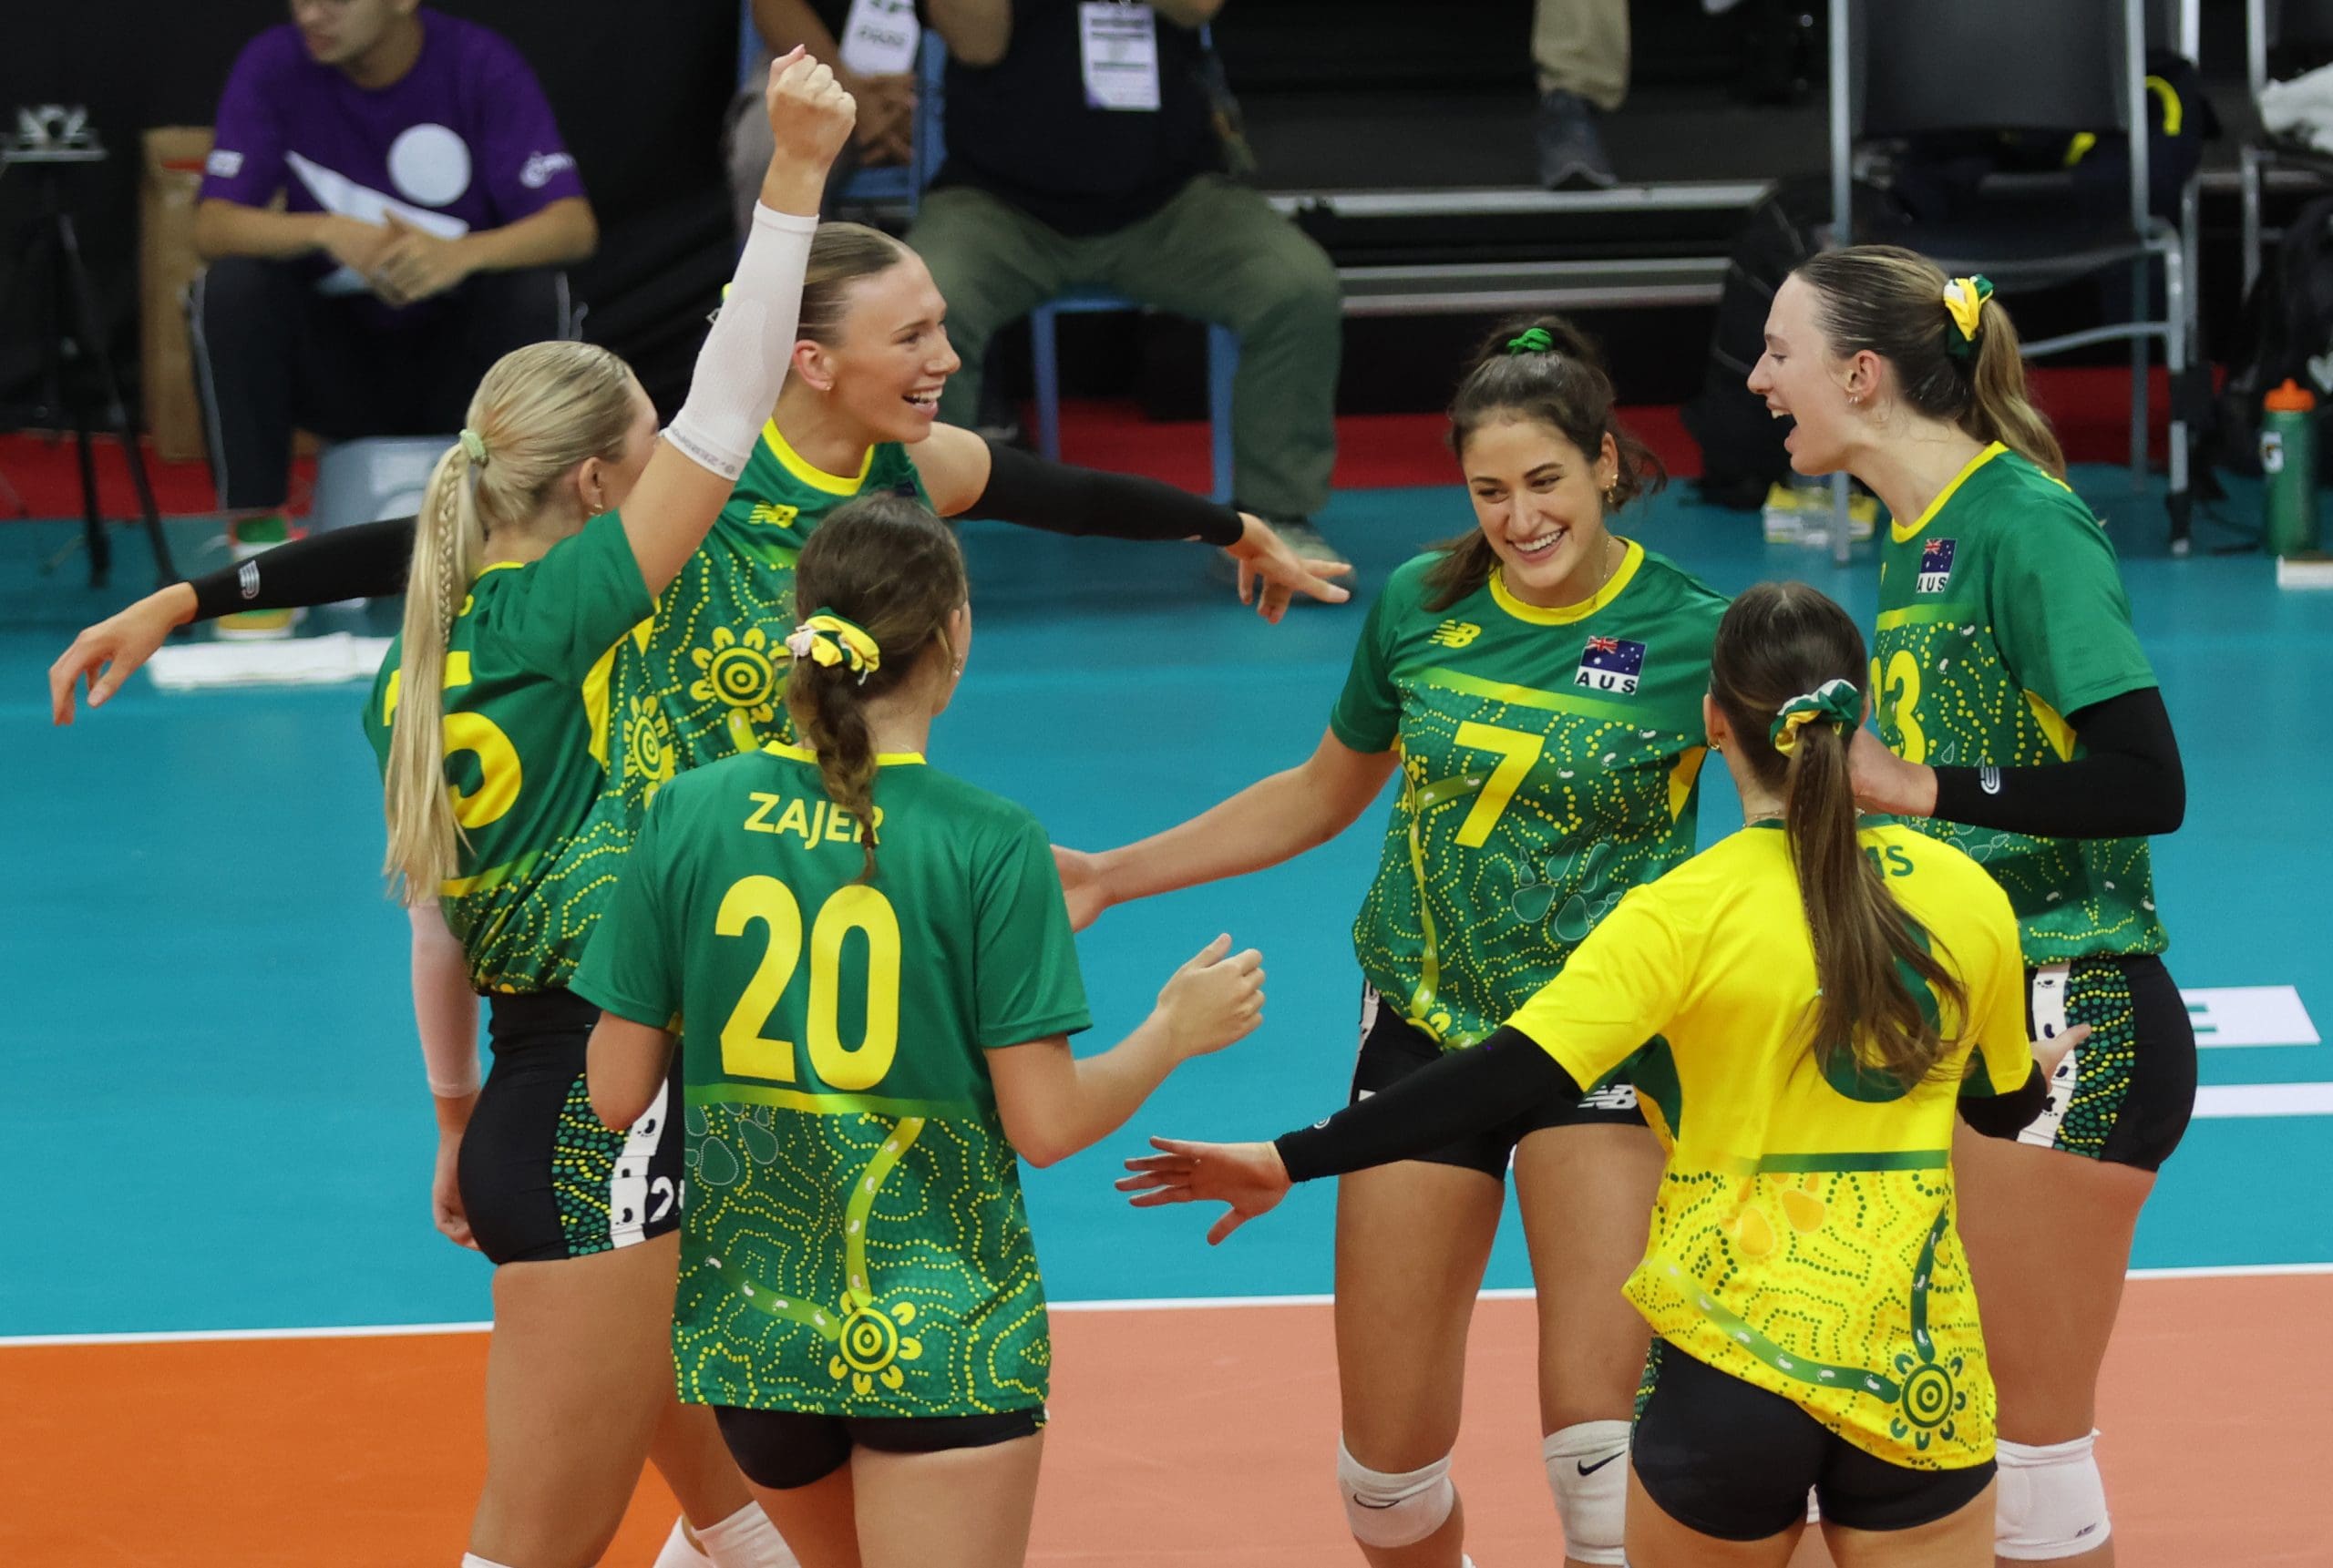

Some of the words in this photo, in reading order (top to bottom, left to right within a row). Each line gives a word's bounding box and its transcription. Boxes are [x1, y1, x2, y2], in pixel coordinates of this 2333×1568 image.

[1917, 576, 1948, 591] AUS
[1577, 671, 1636, 694] AUS
[1454, 721, 1546, 848] 7
[714, 875, 901, 1091] 20
[649, 1176, 685, 1223] 2
